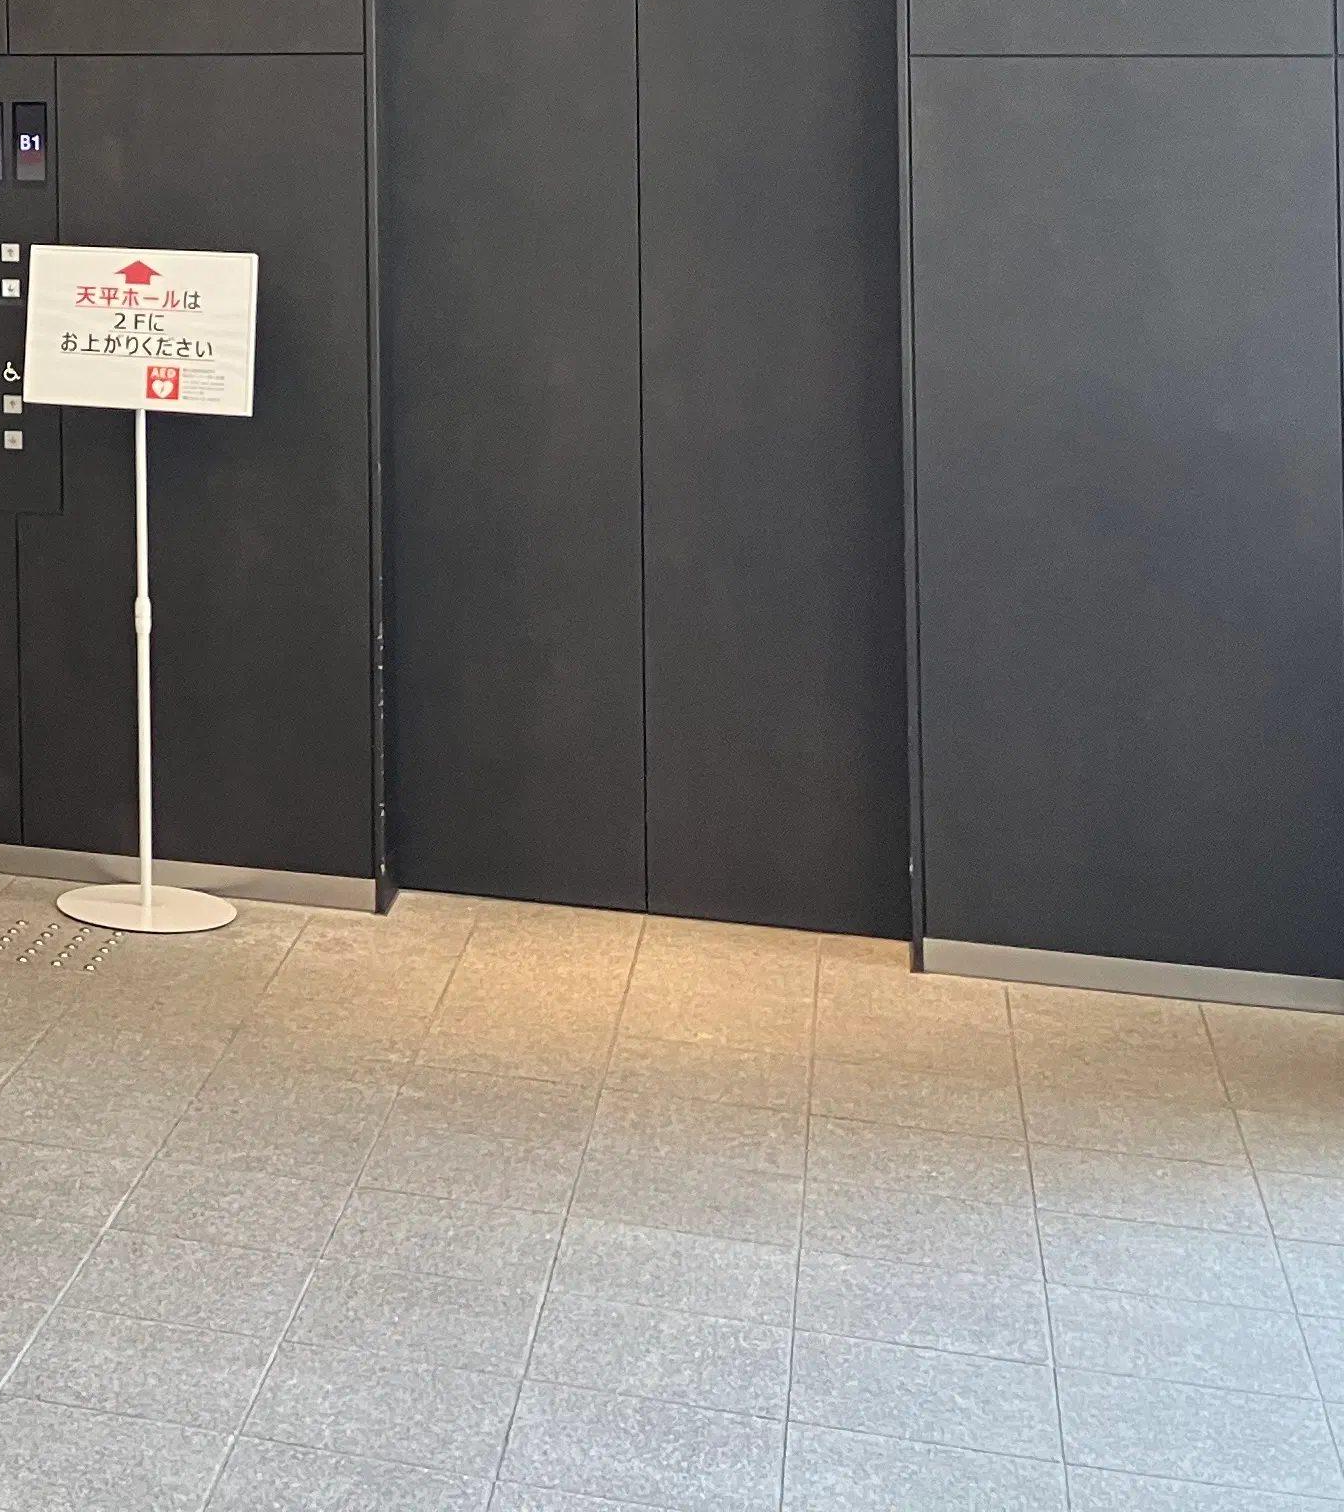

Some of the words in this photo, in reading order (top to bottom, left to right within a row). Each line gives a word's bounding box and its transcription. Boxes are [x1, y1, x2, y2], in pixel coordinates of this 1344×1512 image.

[20, 134, 40, 151] B1
[76, 285, 201, 310] 天平ホールは
[60, 332, 214, 358] お上がりください
[150, 367, 177, 379] AED
